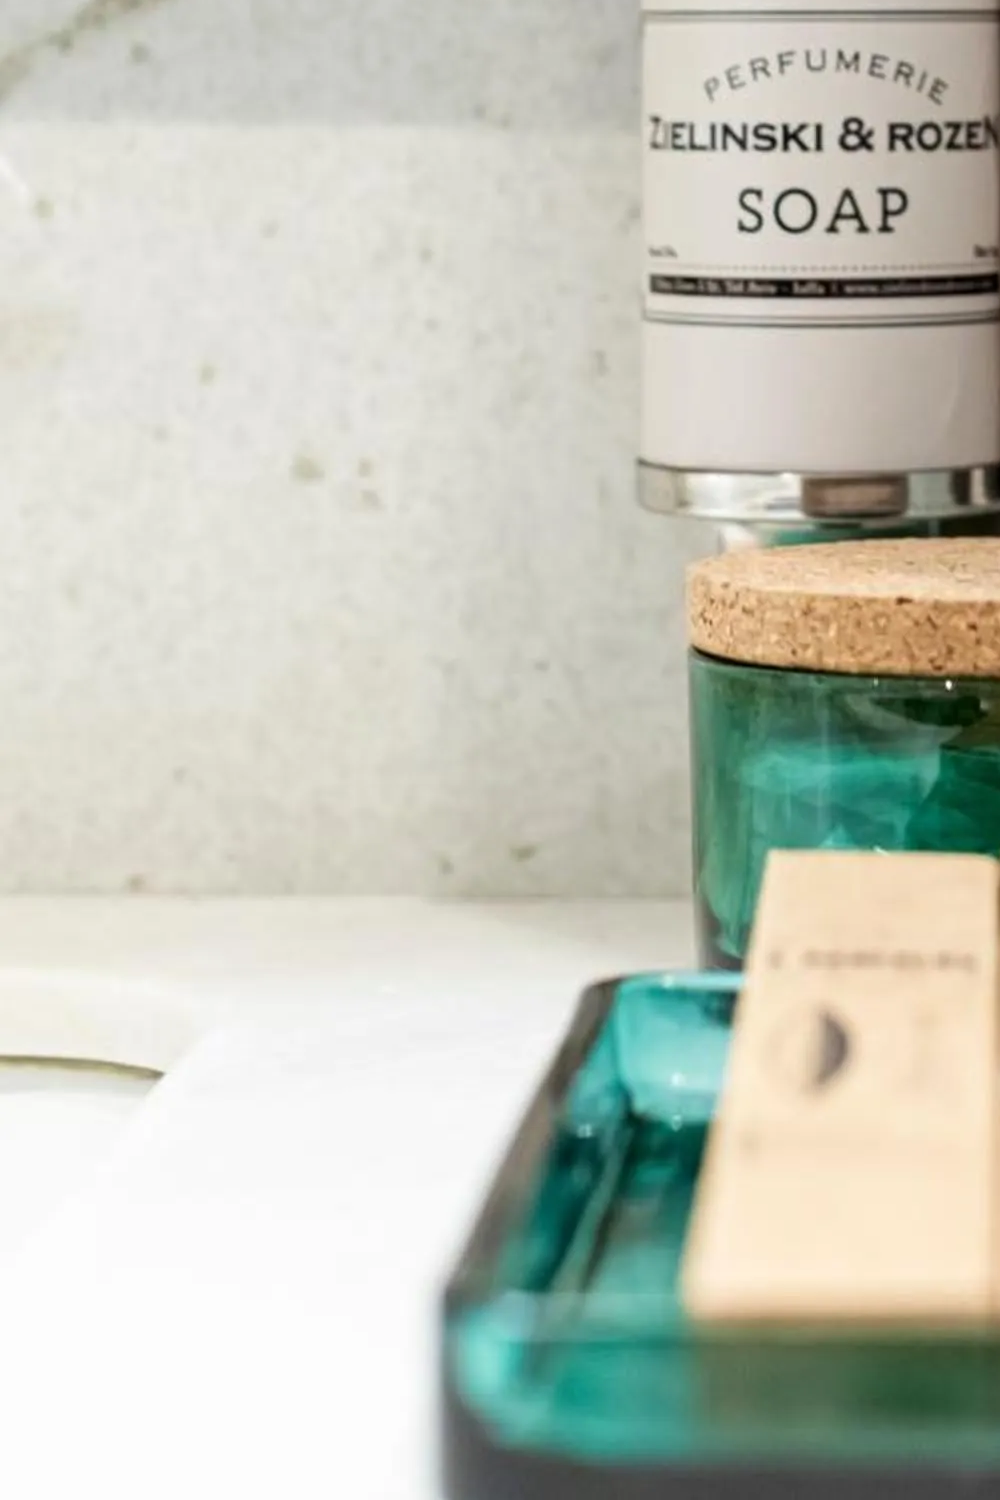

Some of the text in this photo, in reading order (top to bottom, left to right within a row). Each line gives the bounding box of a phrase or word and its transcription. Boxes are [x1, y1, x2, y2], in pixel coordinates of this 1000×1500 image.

[703, 49, 949, 106] PERFUMERIE
[649, 115, 824, 152] ZIELINSKI
[838, 116, 875, 152] &
[737, 187, 909, 234] SOAP
